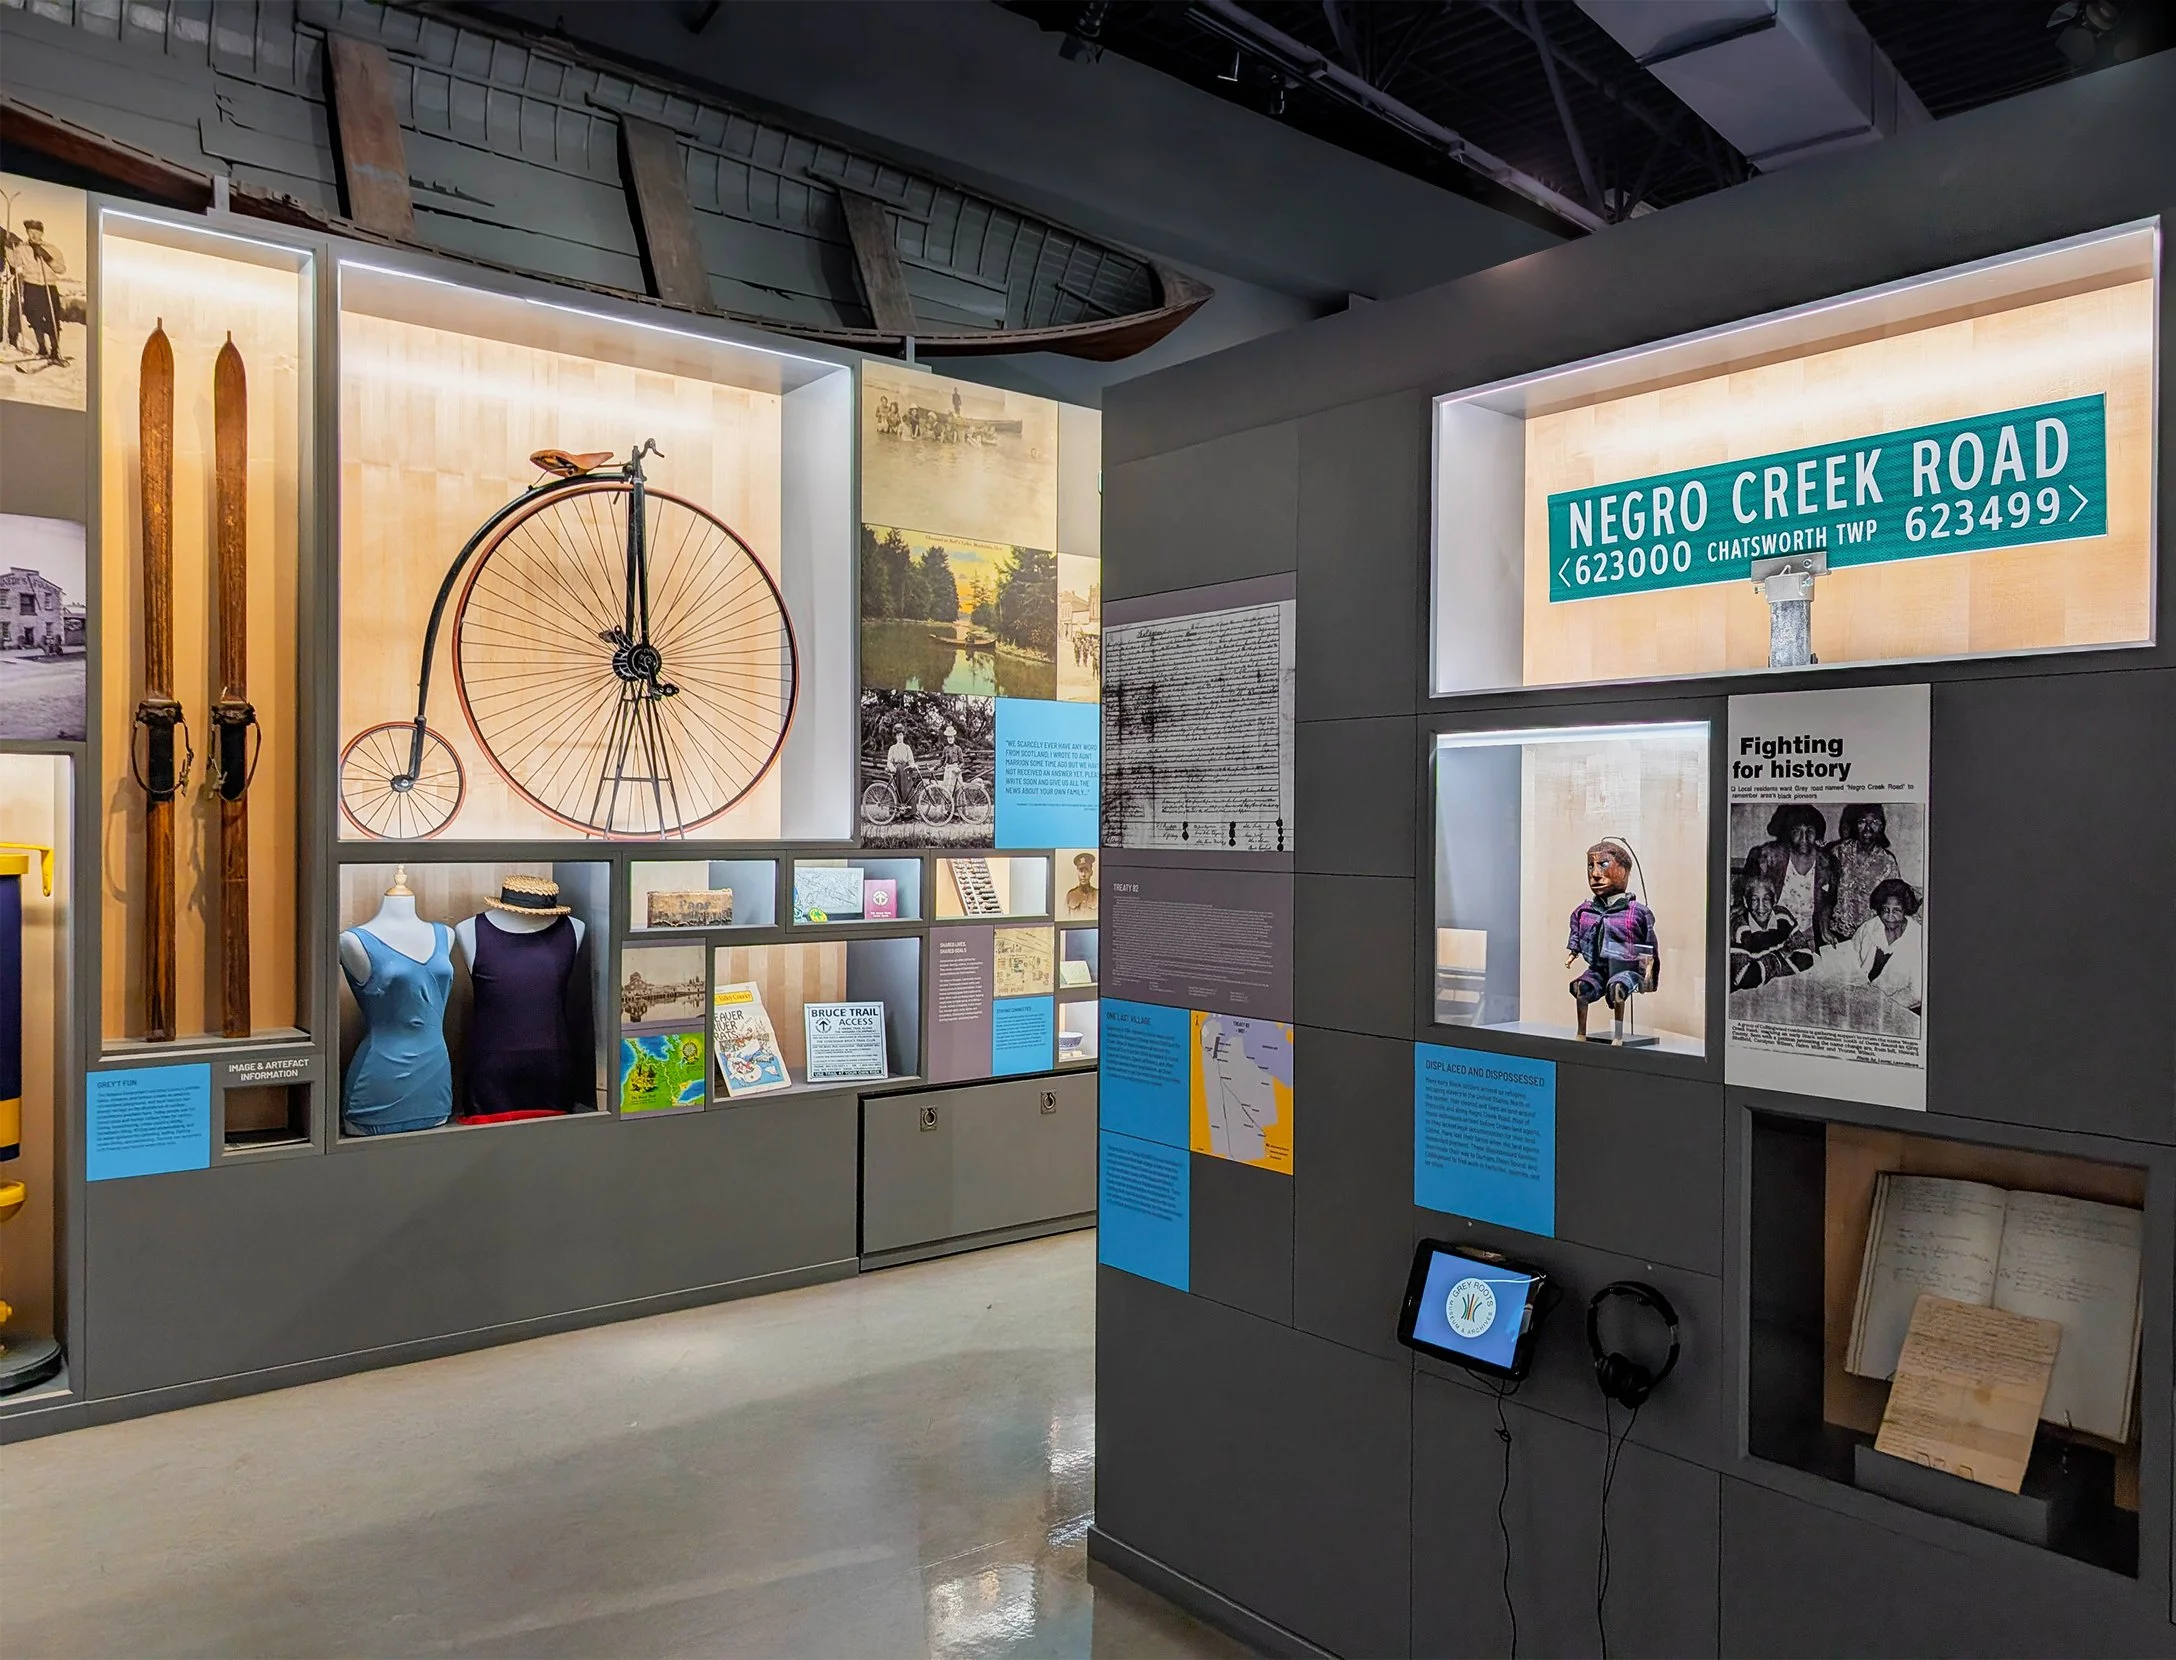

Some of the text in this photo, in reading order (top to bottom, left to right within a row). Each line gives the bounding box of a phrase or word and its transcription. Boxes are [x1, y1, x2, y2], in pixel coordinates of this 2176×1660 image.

[1569, 417, 2070, 549] NEGRO CREEK ROAD
[1575, 486, 2061, 584] 623000 CHATSWORTH TWP 623499
[1017, 740, 1043, 749] SCARCELY
[1740, 735, 1843, 759] Fighting
[1733, 760, 1852, 782] for history
[1113, 883, 1132, 892] TREATY
[714, 1010, 744, 1023] EAVER
[811, 1008, 878, 1017] BRUCE TRAIL
[839, 1018, 873, 1026] ACCESS
[229, 1063, 256, 1072] IMAGE
[265, 1059, 309, 1070] ARTEFACT
[1426, 1060, 1545, 1087] DISPLACED AND DISPOSSESSED
[241, 1069, 298, 1081] INFORMATION
[1452, 1281, 1494, 1308] GREY ROOTS
[1448, 1300, 1460, 1330] MUSEUM
[1467, 1312, 1493, 1335] ARCHIVES
